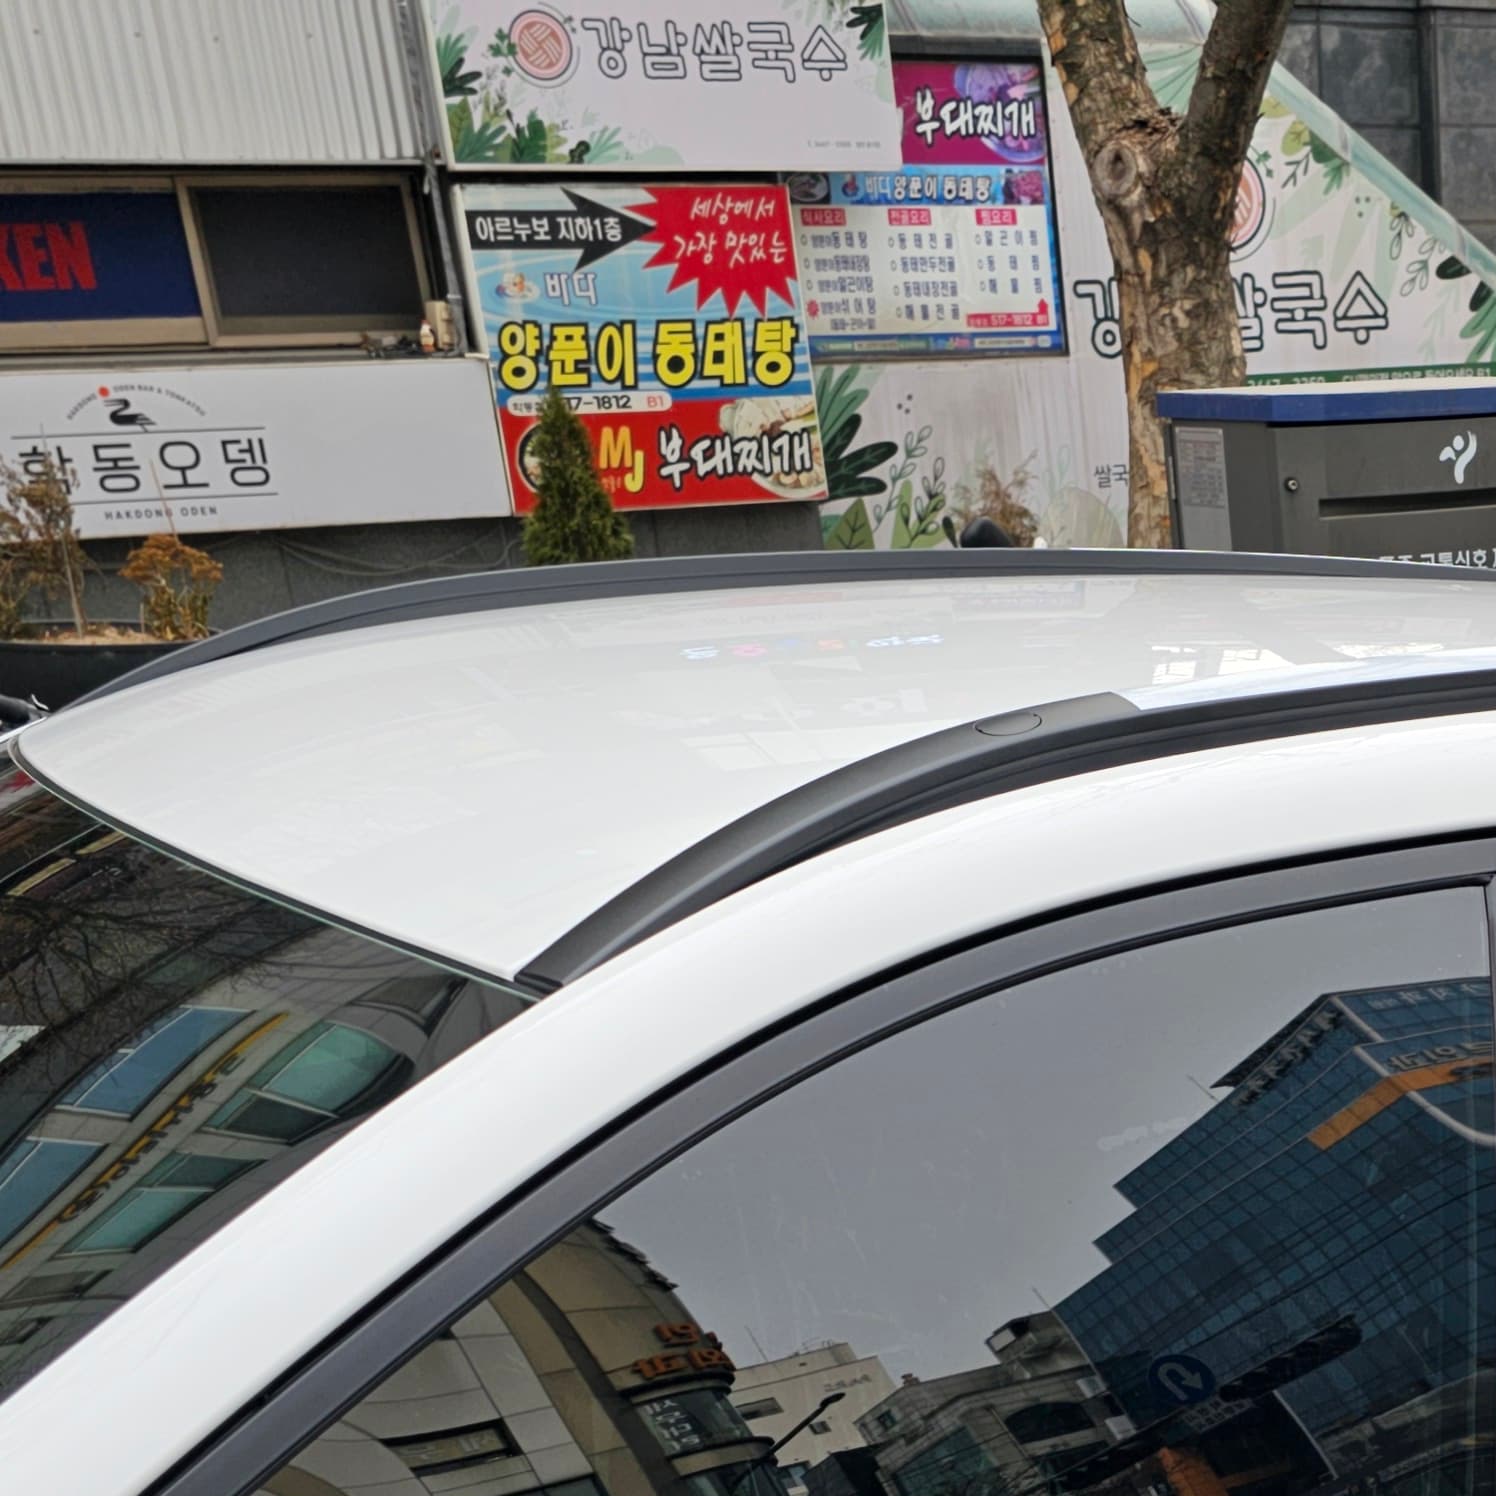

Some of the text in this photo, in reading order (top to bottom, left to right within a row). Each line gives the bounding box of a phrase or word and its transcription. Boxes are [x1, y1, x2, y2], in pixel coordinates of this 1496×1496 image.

[581, 16, 848, 83] 강남쌀국수
[915, 84, 1037, 147] 부대찌개
[690, 193, 776, 224] 세상에서
[475, 216, 623, 242] 아르누보 지하1층
[673, 231, 788, 268] 가장 맛있는
[543, 272, 598, 307] 바다
[498, 317, 799, 391] 양푼이 동태탕
[646, 395, 665, 408] B1
[18, 437, 271, 496] 학동오뎅
[657, 420, 815, 491] 부대찌개
[104, 505, 218, 521] HAKDONG ODEN
